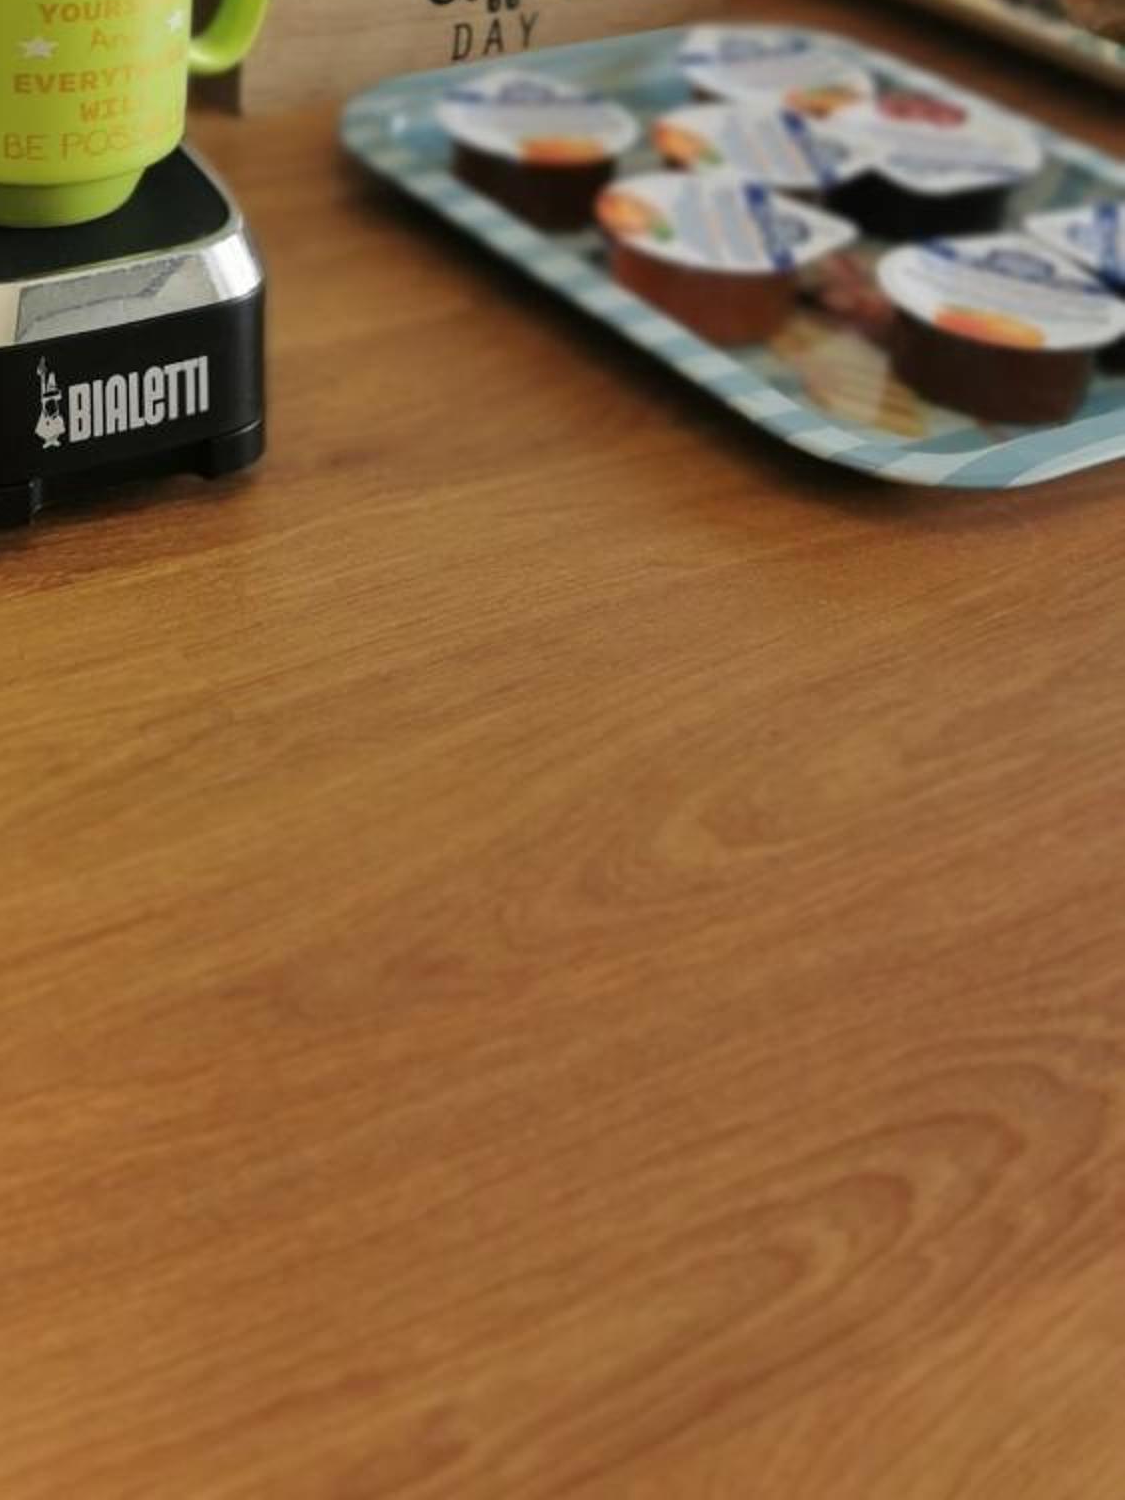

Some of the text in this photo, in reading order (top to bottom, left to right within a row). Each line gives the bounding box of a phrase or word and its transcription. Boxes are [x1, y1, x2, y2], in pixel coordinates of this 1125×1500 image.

[451, 11, 539, 62] DAY
[13, 65, 149, 95] EVERYT
[80, 97, 140, 123] WIL
[3, 132, 46, 161] BE
